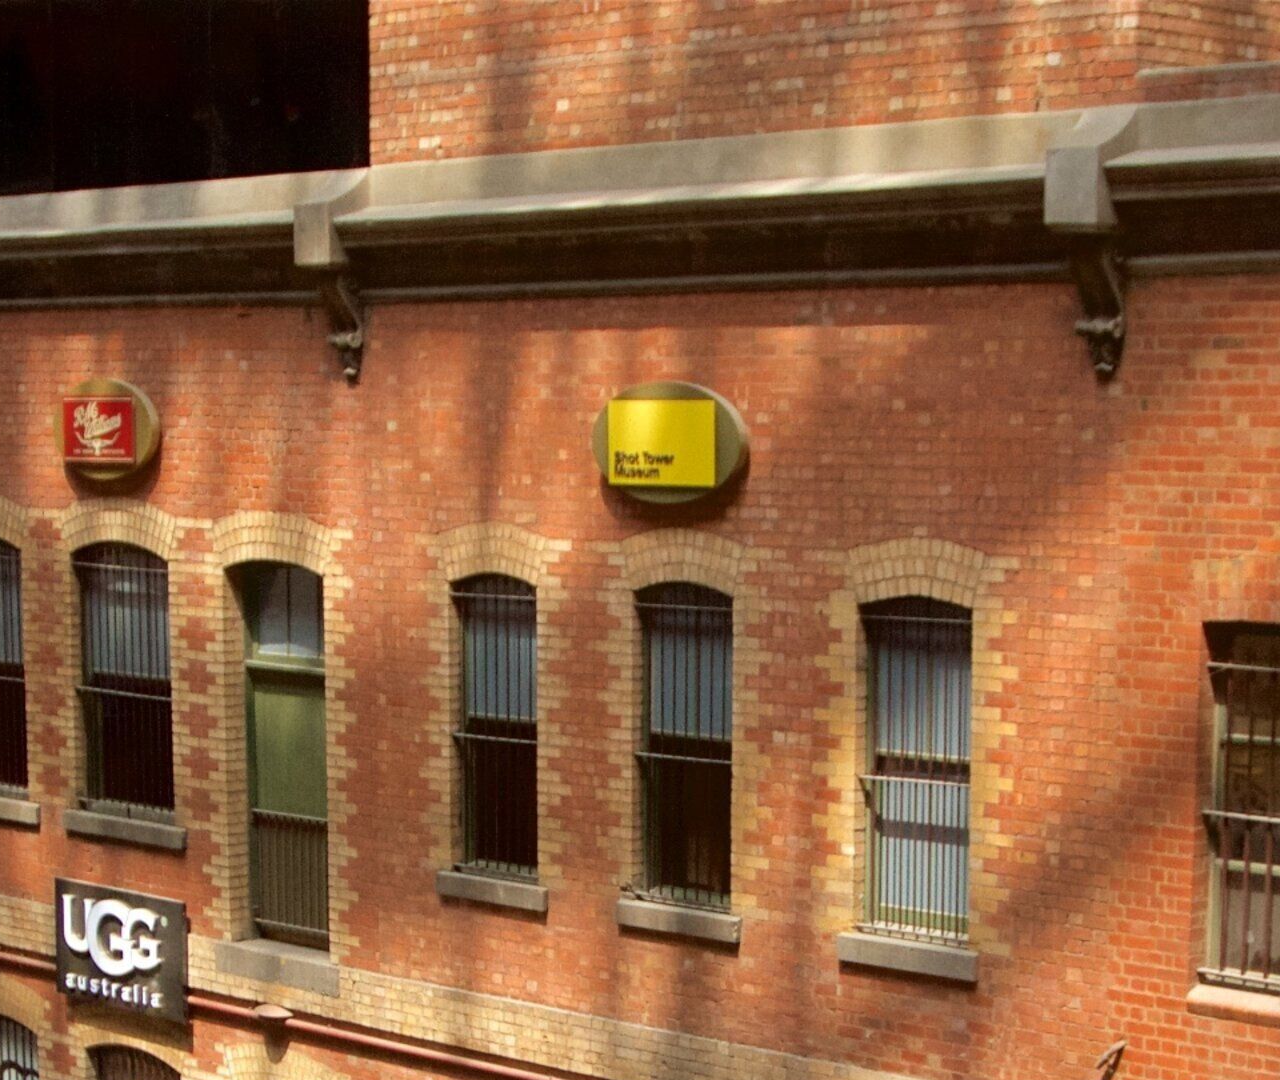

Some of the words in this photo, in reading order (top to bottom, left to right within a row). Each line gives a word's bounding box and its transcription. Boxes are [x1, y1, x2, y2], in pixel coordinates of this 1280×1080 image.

[614, 451, 639, 465] Shot
[643, 451, 674, 466] Tower
[614, 465, 660, 479] Museum
[61, 893, 166, 976] UGG
[65, 972, 164, 1009] australia
